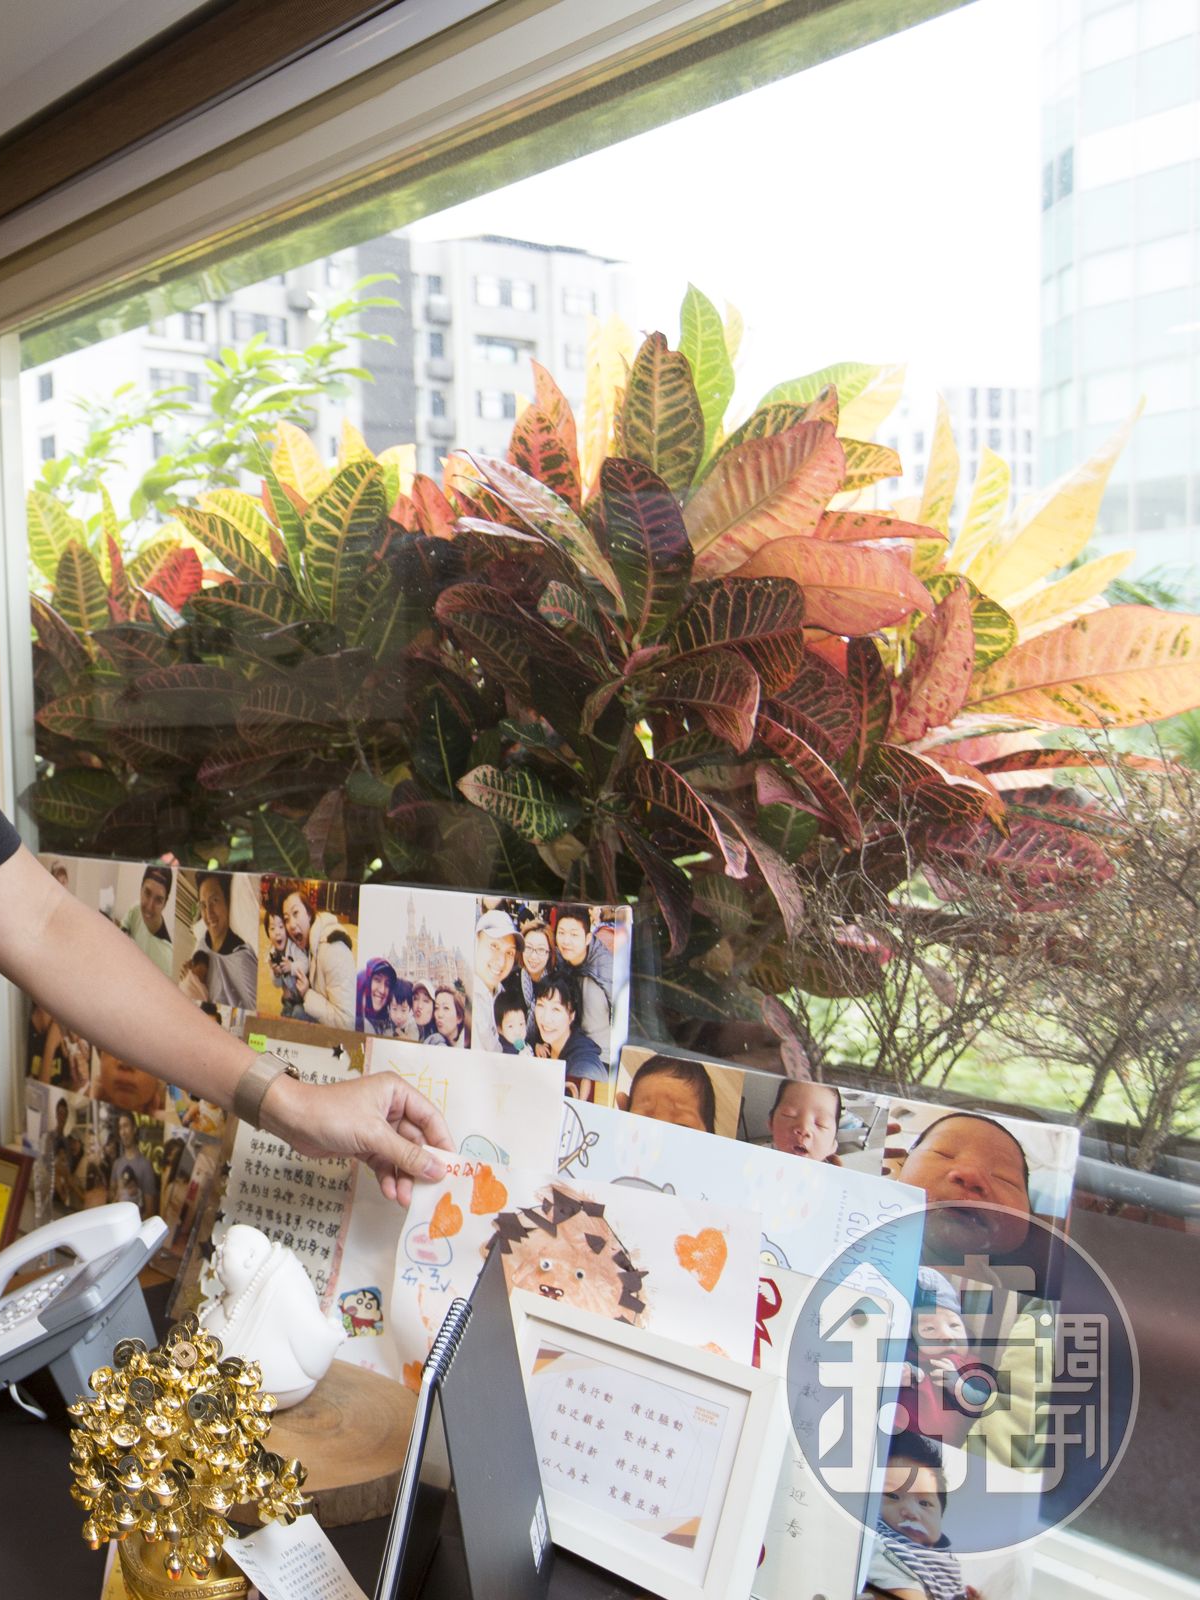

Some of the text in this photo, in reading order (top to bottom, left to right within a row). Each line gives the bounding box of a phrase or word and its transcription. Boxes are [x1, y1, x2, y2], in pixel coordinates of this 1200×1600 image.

[557, 1403, 677, 1460] 貼近顧客 堅持本業
[630, 1402, 684, 1432] 價值驅動
[541, 1457, 590, 1485] 以人為本
[550, 1429, 669, 1489] 自主創新 精兵簡政
